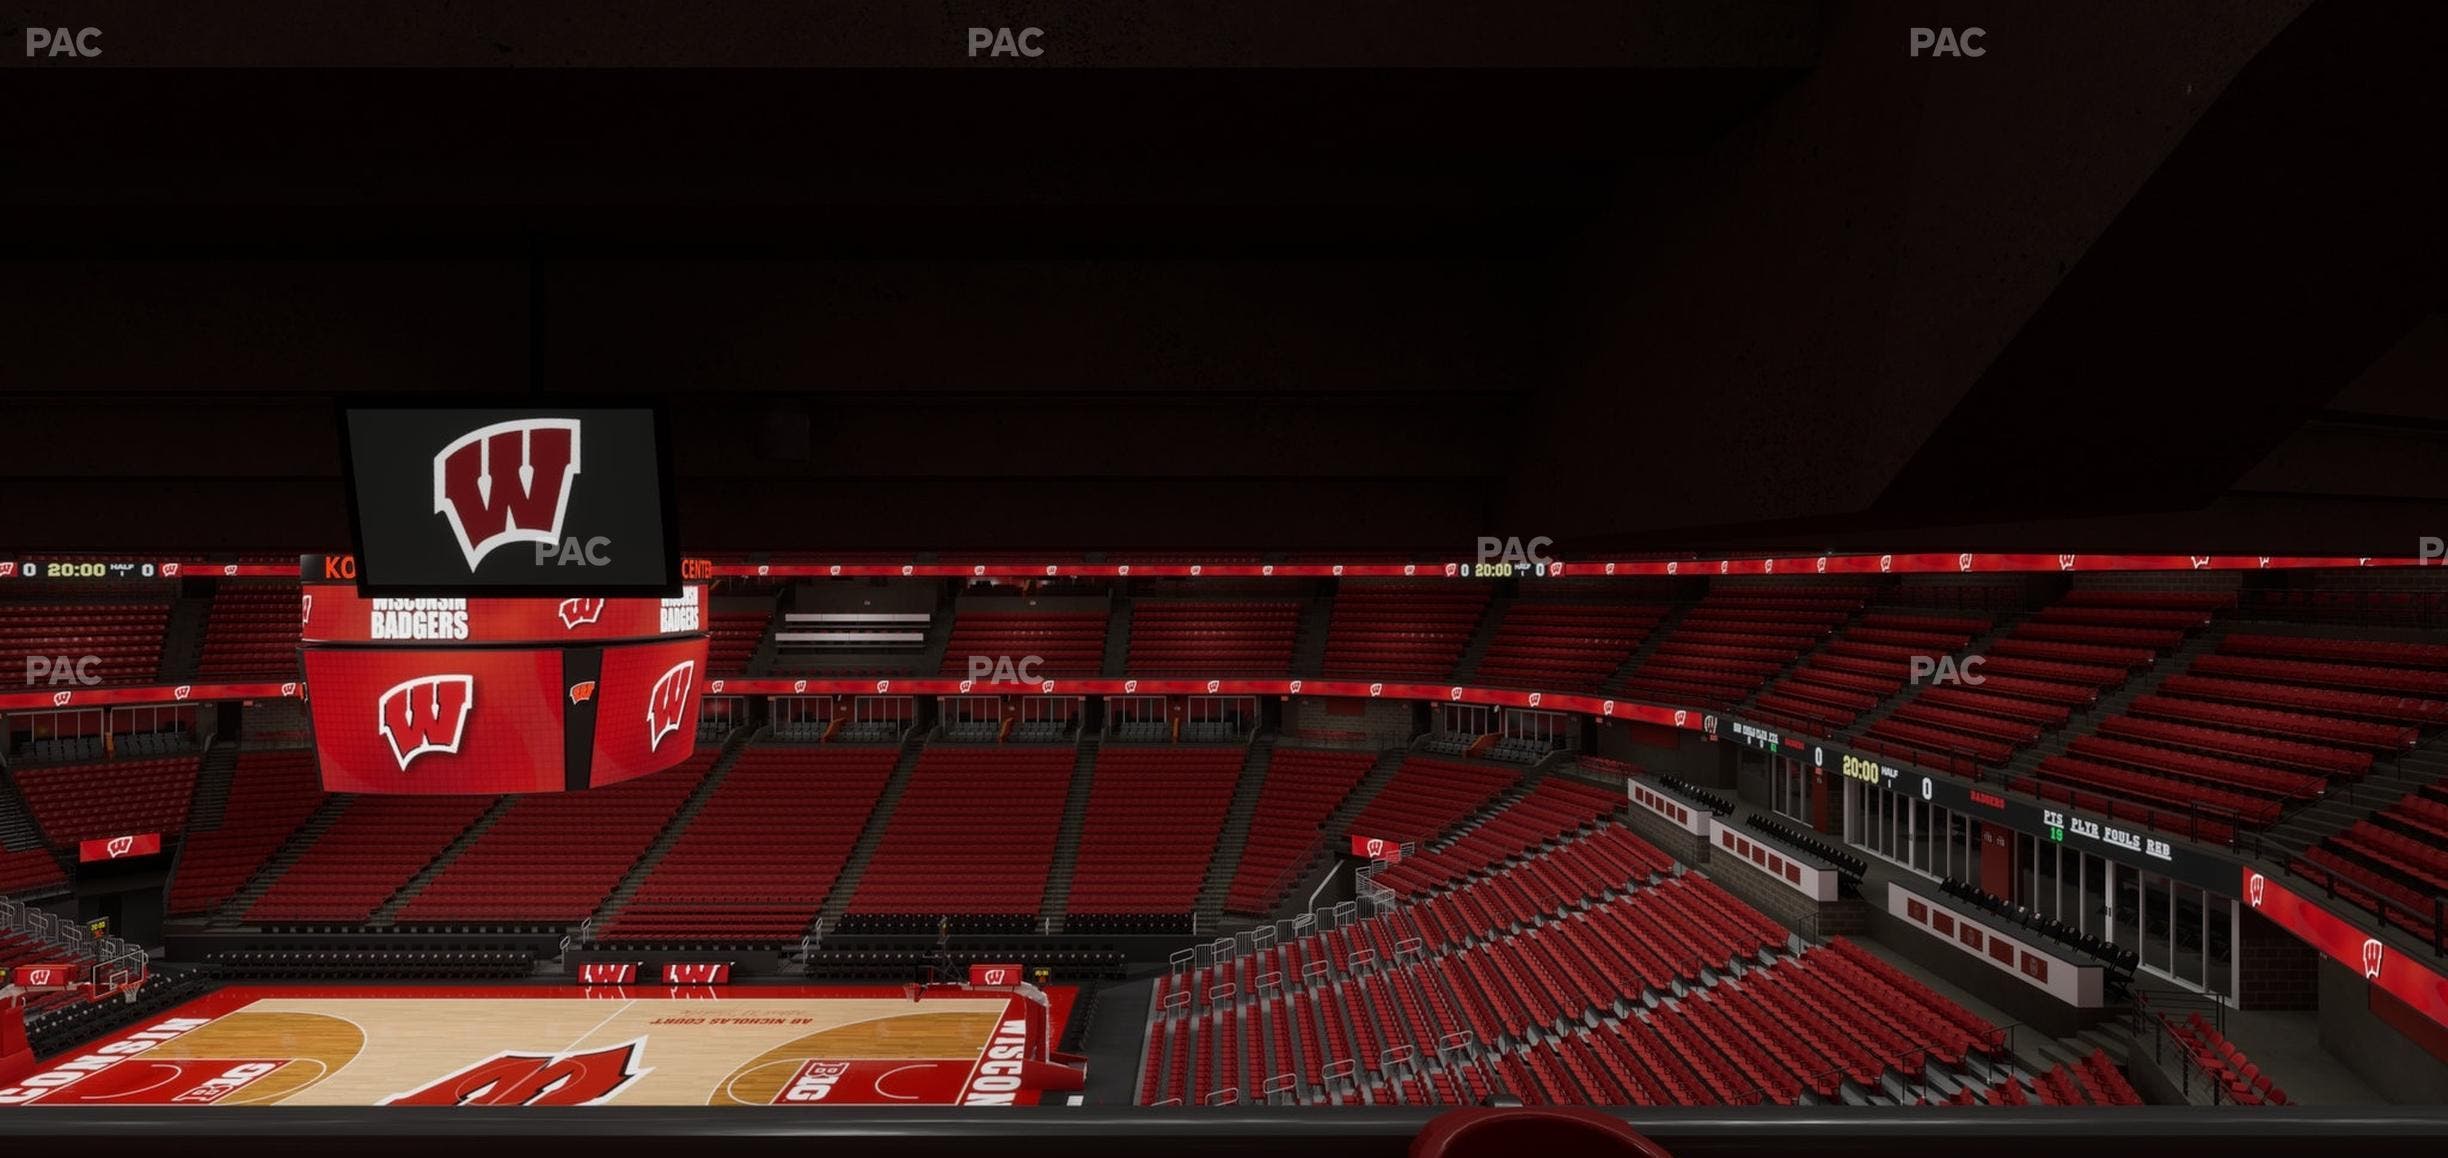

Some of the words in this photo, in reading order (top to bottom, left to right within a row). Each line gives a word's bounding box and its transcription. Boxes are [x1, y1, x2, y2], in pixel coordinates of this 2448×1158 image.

[433, 418, 581, 574] W
[22, 563, 37, 577] 0
[47, 563, 106, 577] 20:00
[141, 563, 154, 577] 0
[1460, 563, 1470, 577] 0
[1475, 563, 1512, 577] 20:00
[1535, 563, 1545, 577] 0
[370, 611, 469, 640] BADGERS
[379, 674, 474, 772] W
[647, 660, 695, 752] W
[1814, 746, 1823, 767] 0
[1843, 755, 1879, 784] 20:00
[1881, 765, 1899, 779] HALF
[1922, 777, 1933, 801] 0
[2043, 809, 2064, 829] PTS
[2070, 817, 2100, 840] PLYR
[2102, 826, 2142, 852] FOULS
[2050, 826, 2063, 842] 19
